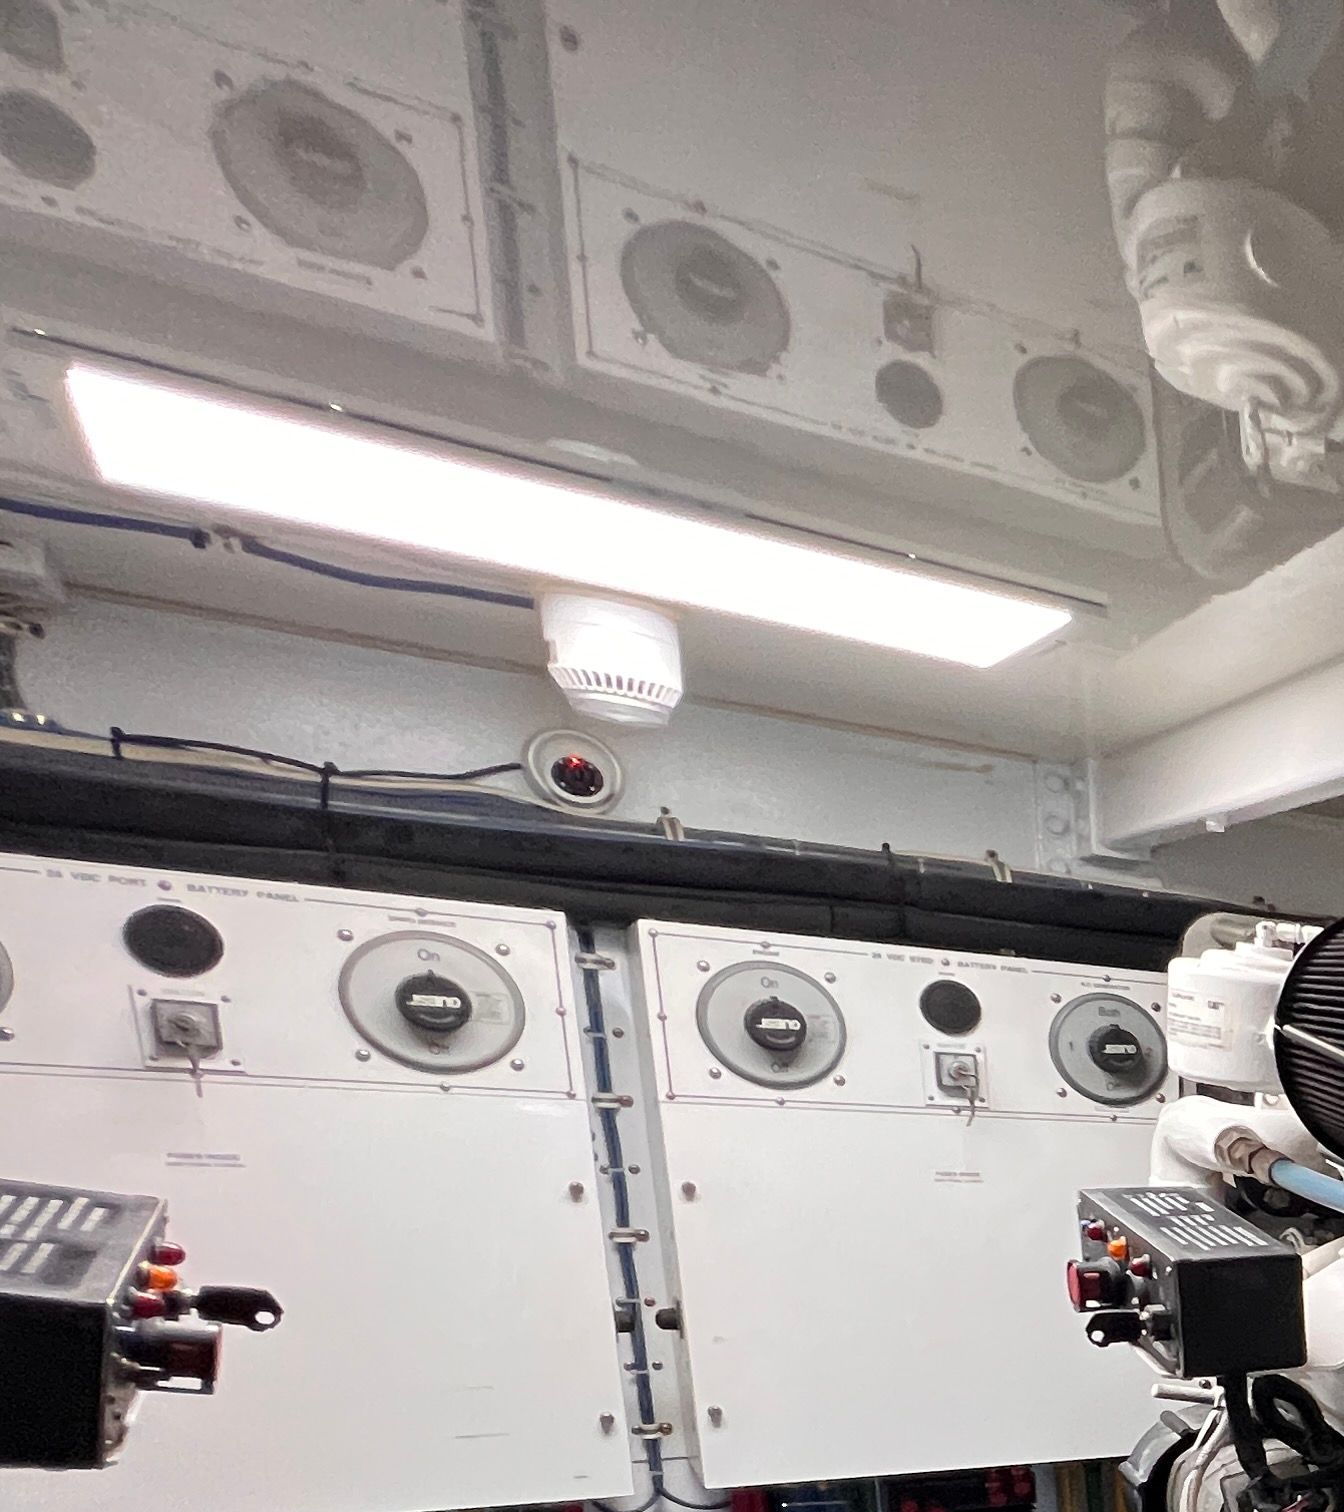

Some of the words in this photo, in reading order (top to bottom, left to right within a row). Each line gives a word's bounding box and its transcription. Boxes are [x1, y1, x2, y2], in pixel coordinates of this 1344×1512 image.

[108, 874, 147, 887] PORT
[187, 884, 248, 897] BATTERY
[257, 890, 299, 902] PANEL
[417, 949, 441, 962] On
[957, 961, 997, 970] BATTERY
[760, 976, 780, 989] On
